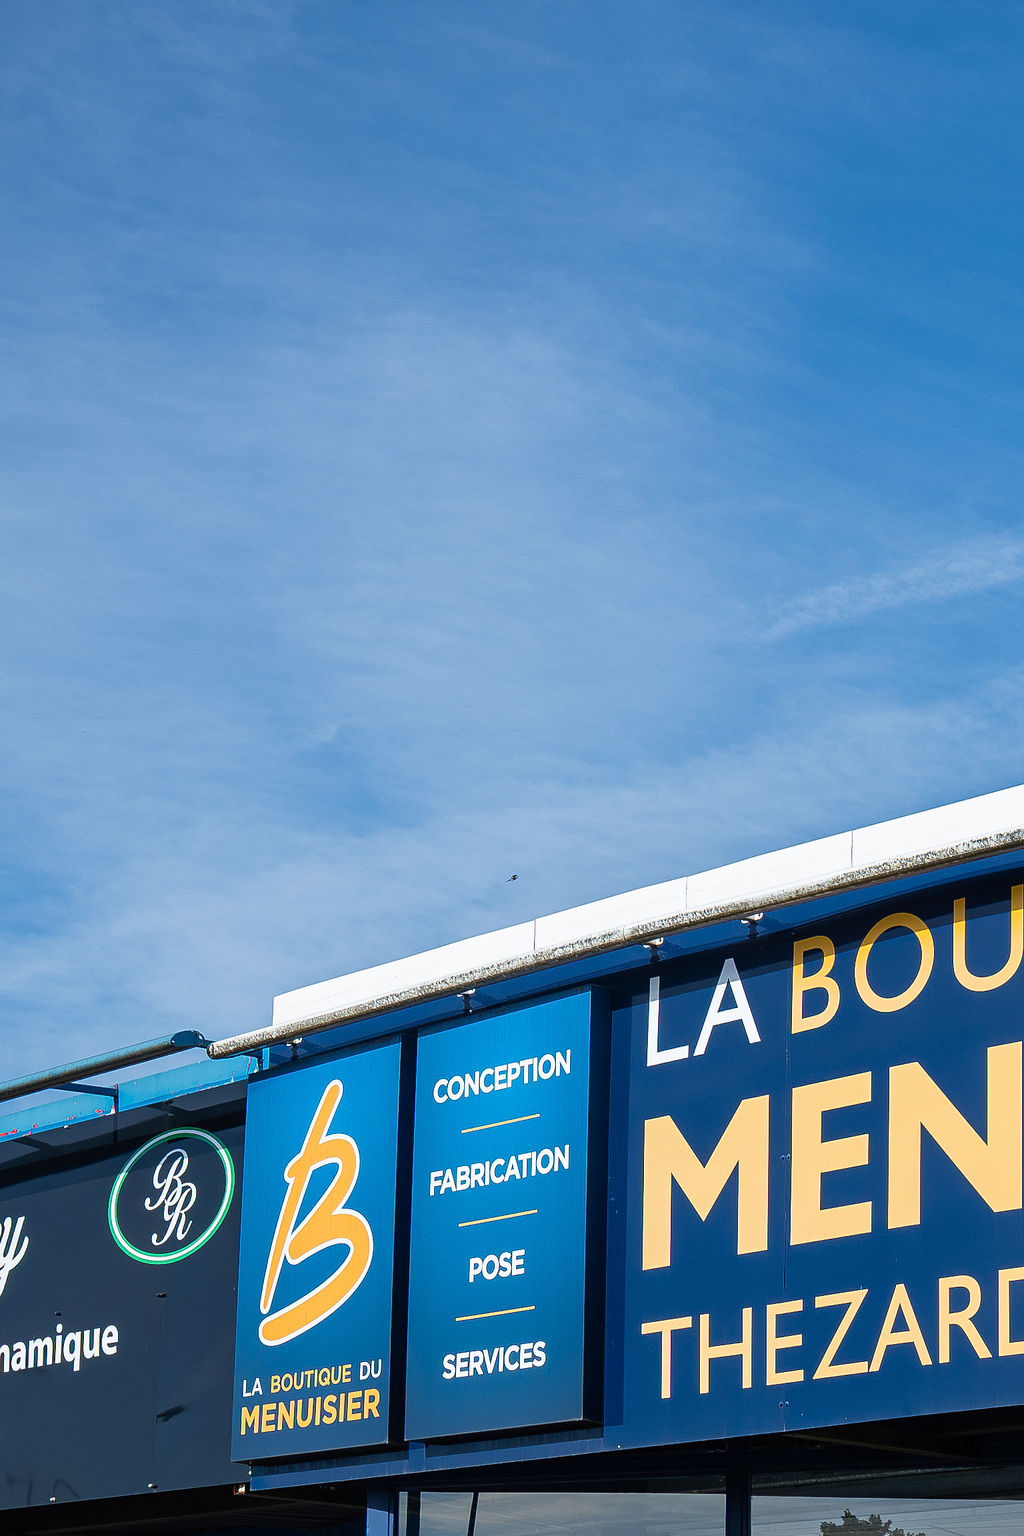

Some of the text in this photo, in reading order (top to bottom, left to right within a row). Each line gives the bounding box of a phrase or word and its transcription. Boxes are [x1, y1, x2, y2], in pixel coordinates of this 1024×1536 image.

[647, 957, 761, 1067] LA
[433, 1049, 573, 1104] CONCEPTION
[429, 1145, 571, 1197] FABRICATION
[468, 1249, 526, 1283] POSE
[241, 1358, 383, 1398] LA BOUTIQUE DU
[442, 1341, 547, 1381] SERVICES
[239, 1388, 381, 1436] MENUISIER
